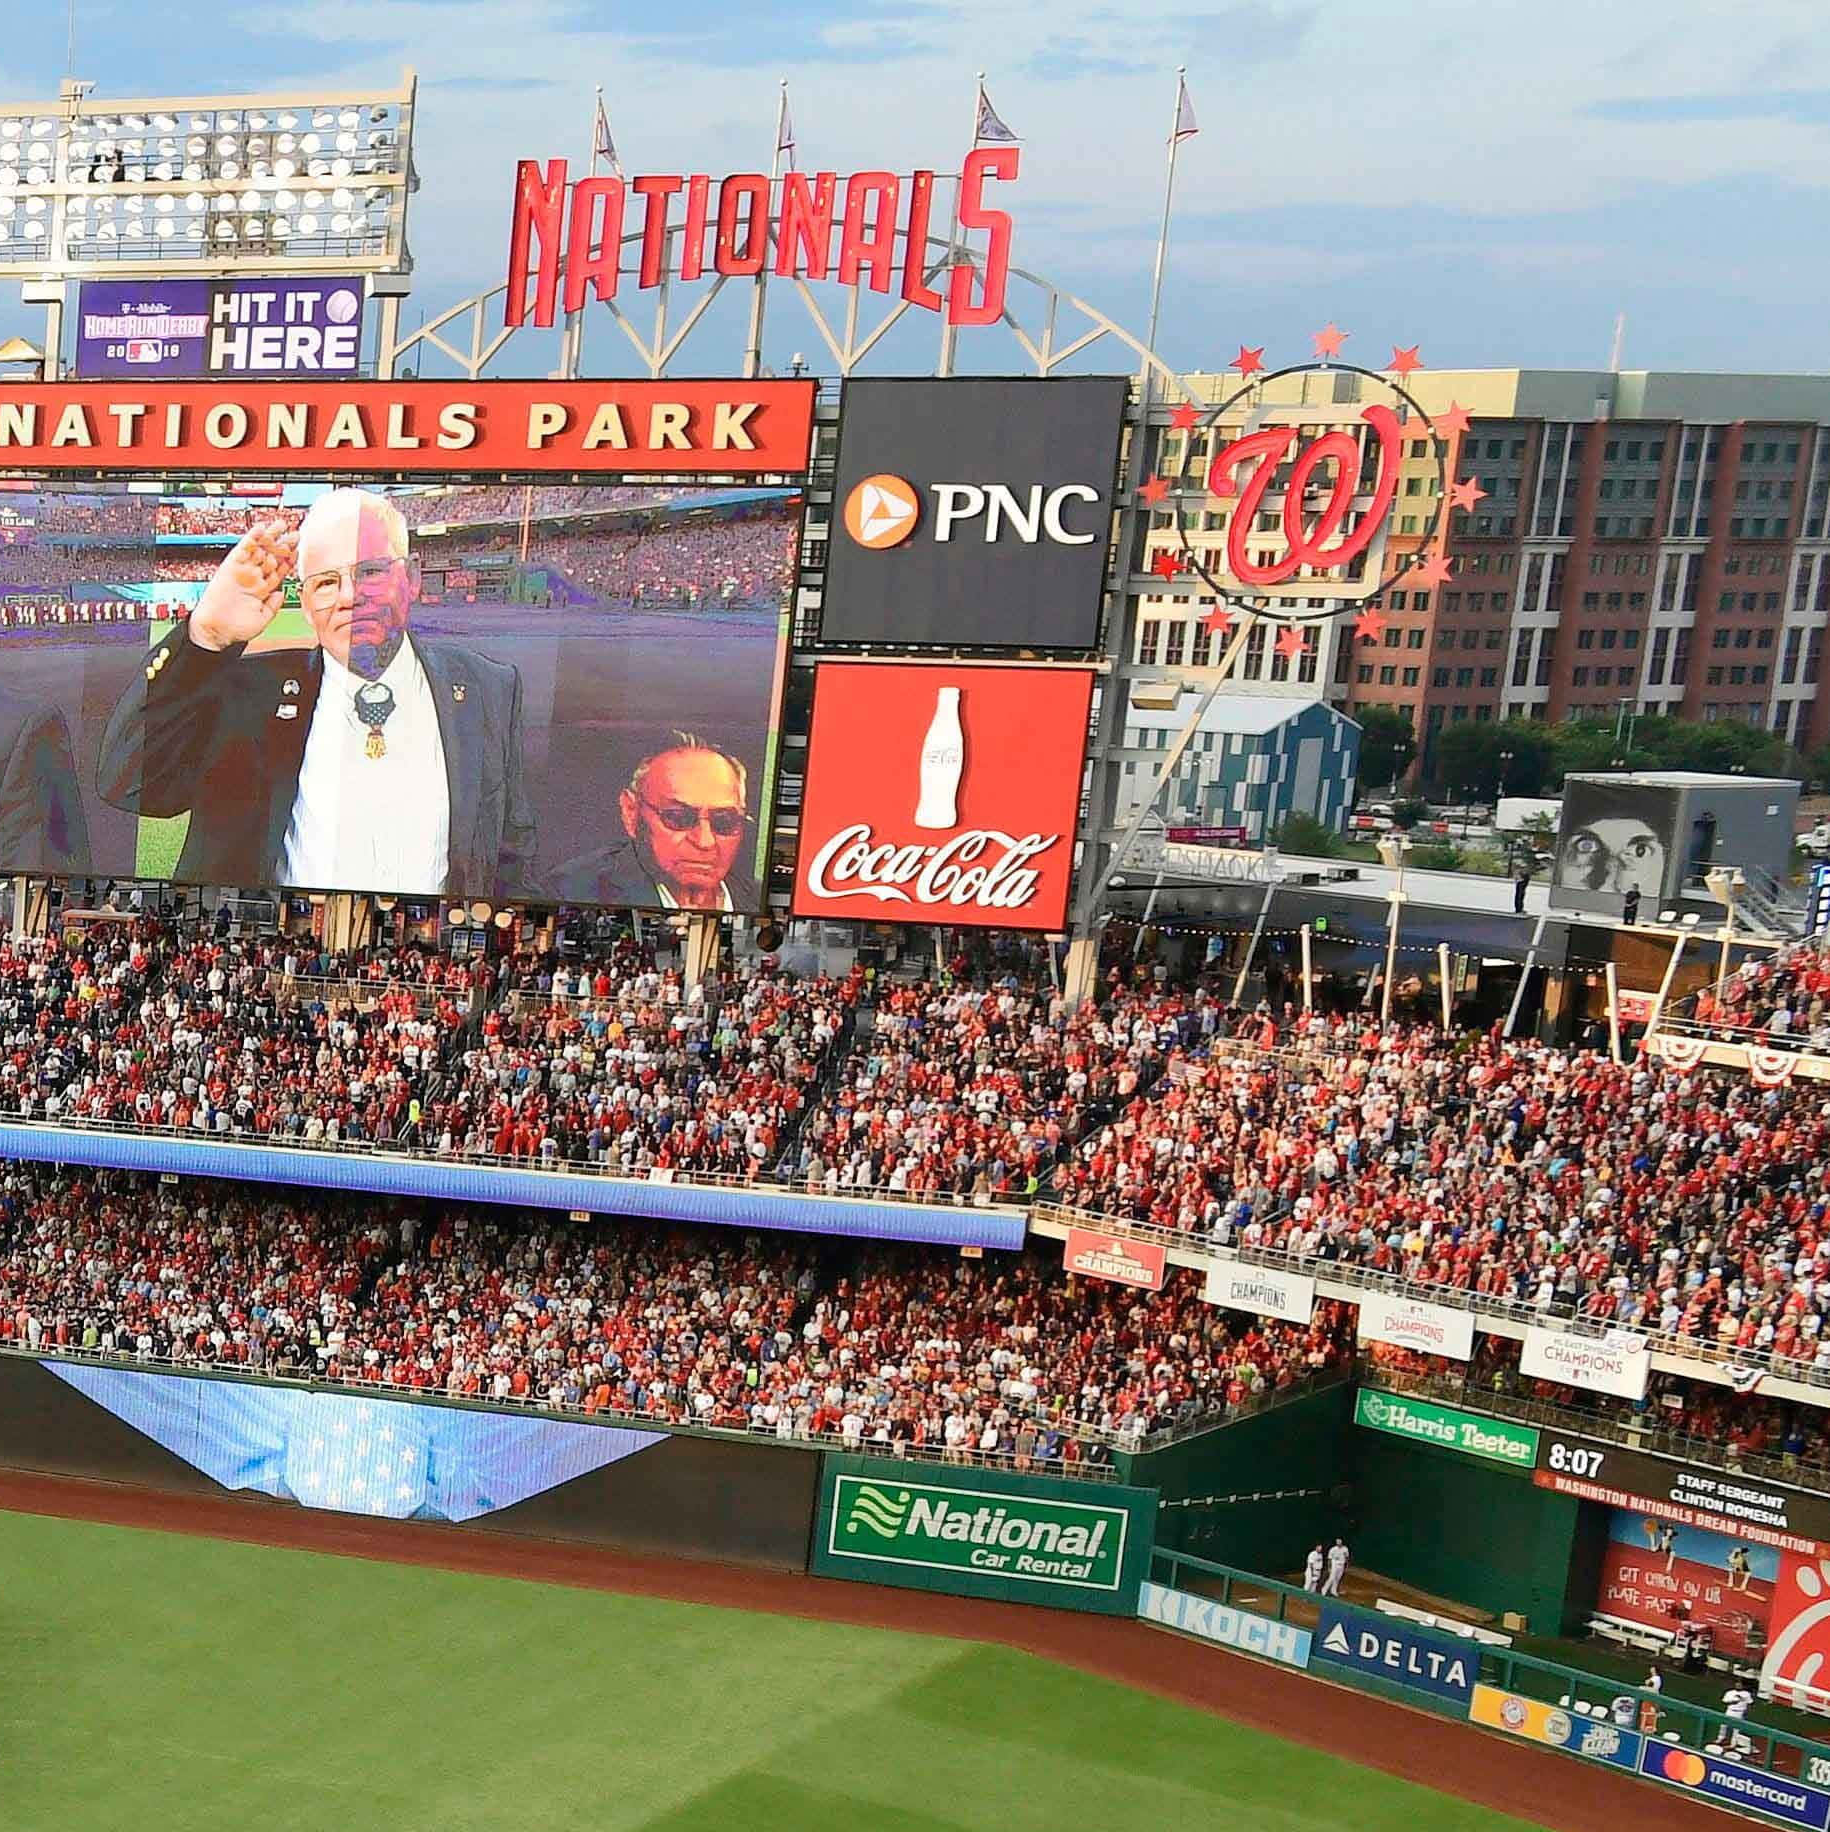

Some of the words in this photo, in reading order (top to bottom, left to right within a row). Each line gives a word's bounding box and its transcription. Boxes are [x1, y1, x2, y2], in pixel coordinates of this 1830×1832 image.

[505, 146, 1021, 328] NATIONALS
[214, 292, 276, 323] HIT
[285, 292, 321, 323] IT
[209, 325, 358, 370] HERE
[528, 402, 759, 451] PARK
[934, 484, 1099, 547] PNC
[807, 823, 1057, 910] Coca-Cola
[1072, 1253, 1154, 1283] CHAMPIONS
[1230, 1281, 1286, 1310] CHAMPIONS
[1384, 1316, 1445, 1343] CHAMPIONS
[1544, 1346, 1623, 1374] CHAMPIONS
[1387, 1402, 1456, 1442] Harris
[1460, 1423, 1532, 1460] Teeter
[1548, 1443, 1605, 1478] 8:07
[1670, 1489, 1724, 1511] CLINTON
[1724, 1502, 1788, 1528] ROMESHA
[1677, 1473, 1717, 1495] STAFF
[1717, 1484, 1786, 1509] SERGEANT
[906, 1497, 1106, 1558] National
[1555, 1477, 1628, 1508] WASHINGTON
[1630, 1496, 1693, 1524] NATIONALS
[1696, 1511, 1738, 1534] DREAM
[1739, 1523, 1815, 1555] FOUNDATION
[969, 1548, 1010, 1568] Car
[1015, 1554, 1093, 1579] Rental
[1187, 1601, 1301, 1663] KOCH
[1358, 1631, 1469, 1688] DELTA
[1710, 1768, 1807, 1812] mastercard
